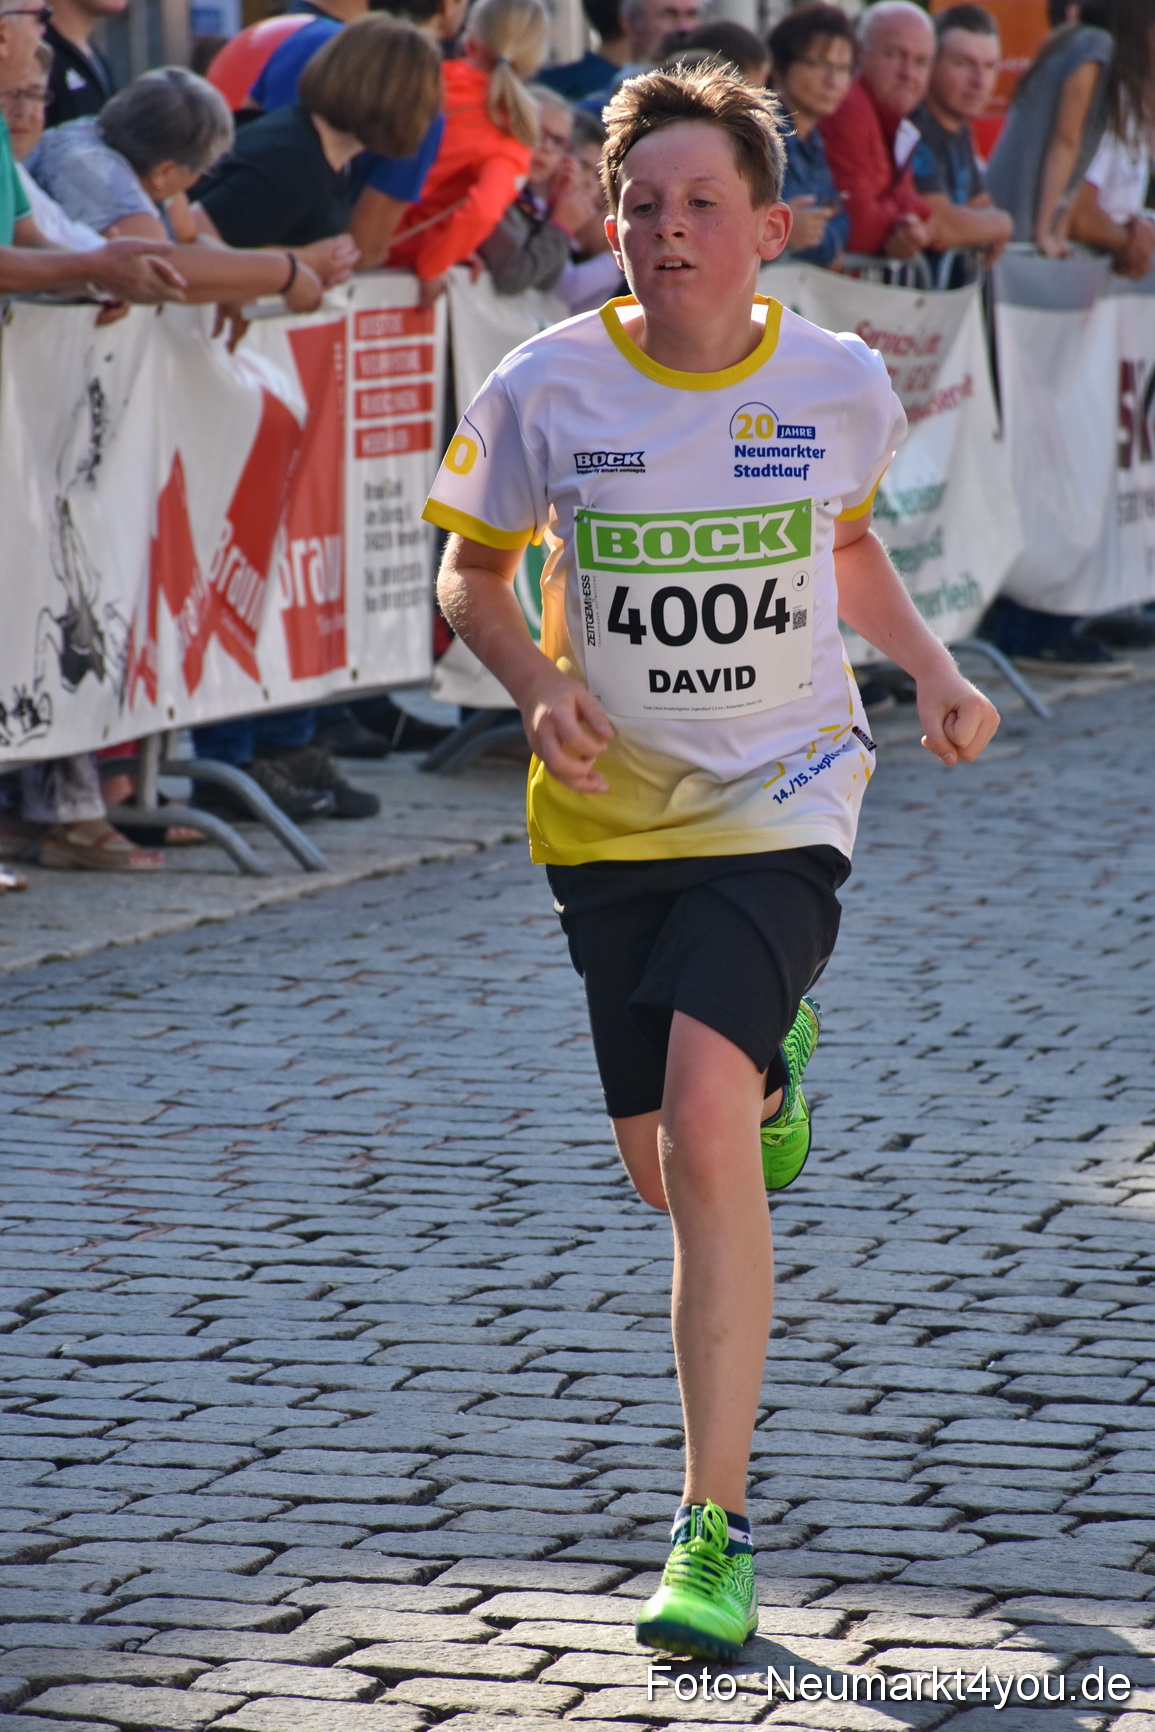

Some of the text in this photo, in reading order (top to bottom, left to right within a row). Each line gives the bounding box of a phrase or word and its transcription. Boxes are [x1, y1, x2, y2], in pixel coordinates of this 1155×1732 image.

[735, 413, 813, 439] 20 JAHRE
[574, 451, 645, 468] BOCK
[735, 444, 826, 459] Neumarkter
[734, 464, 810, 481] Stadtlauf
[593, 513, 793, 562] BOCK
[796, 575, 804, 587] J
[608, 578, 790, 646] 4004
[648, 665, 756, 694] DAVID
[773, 772, 813, 805] 14./15.
